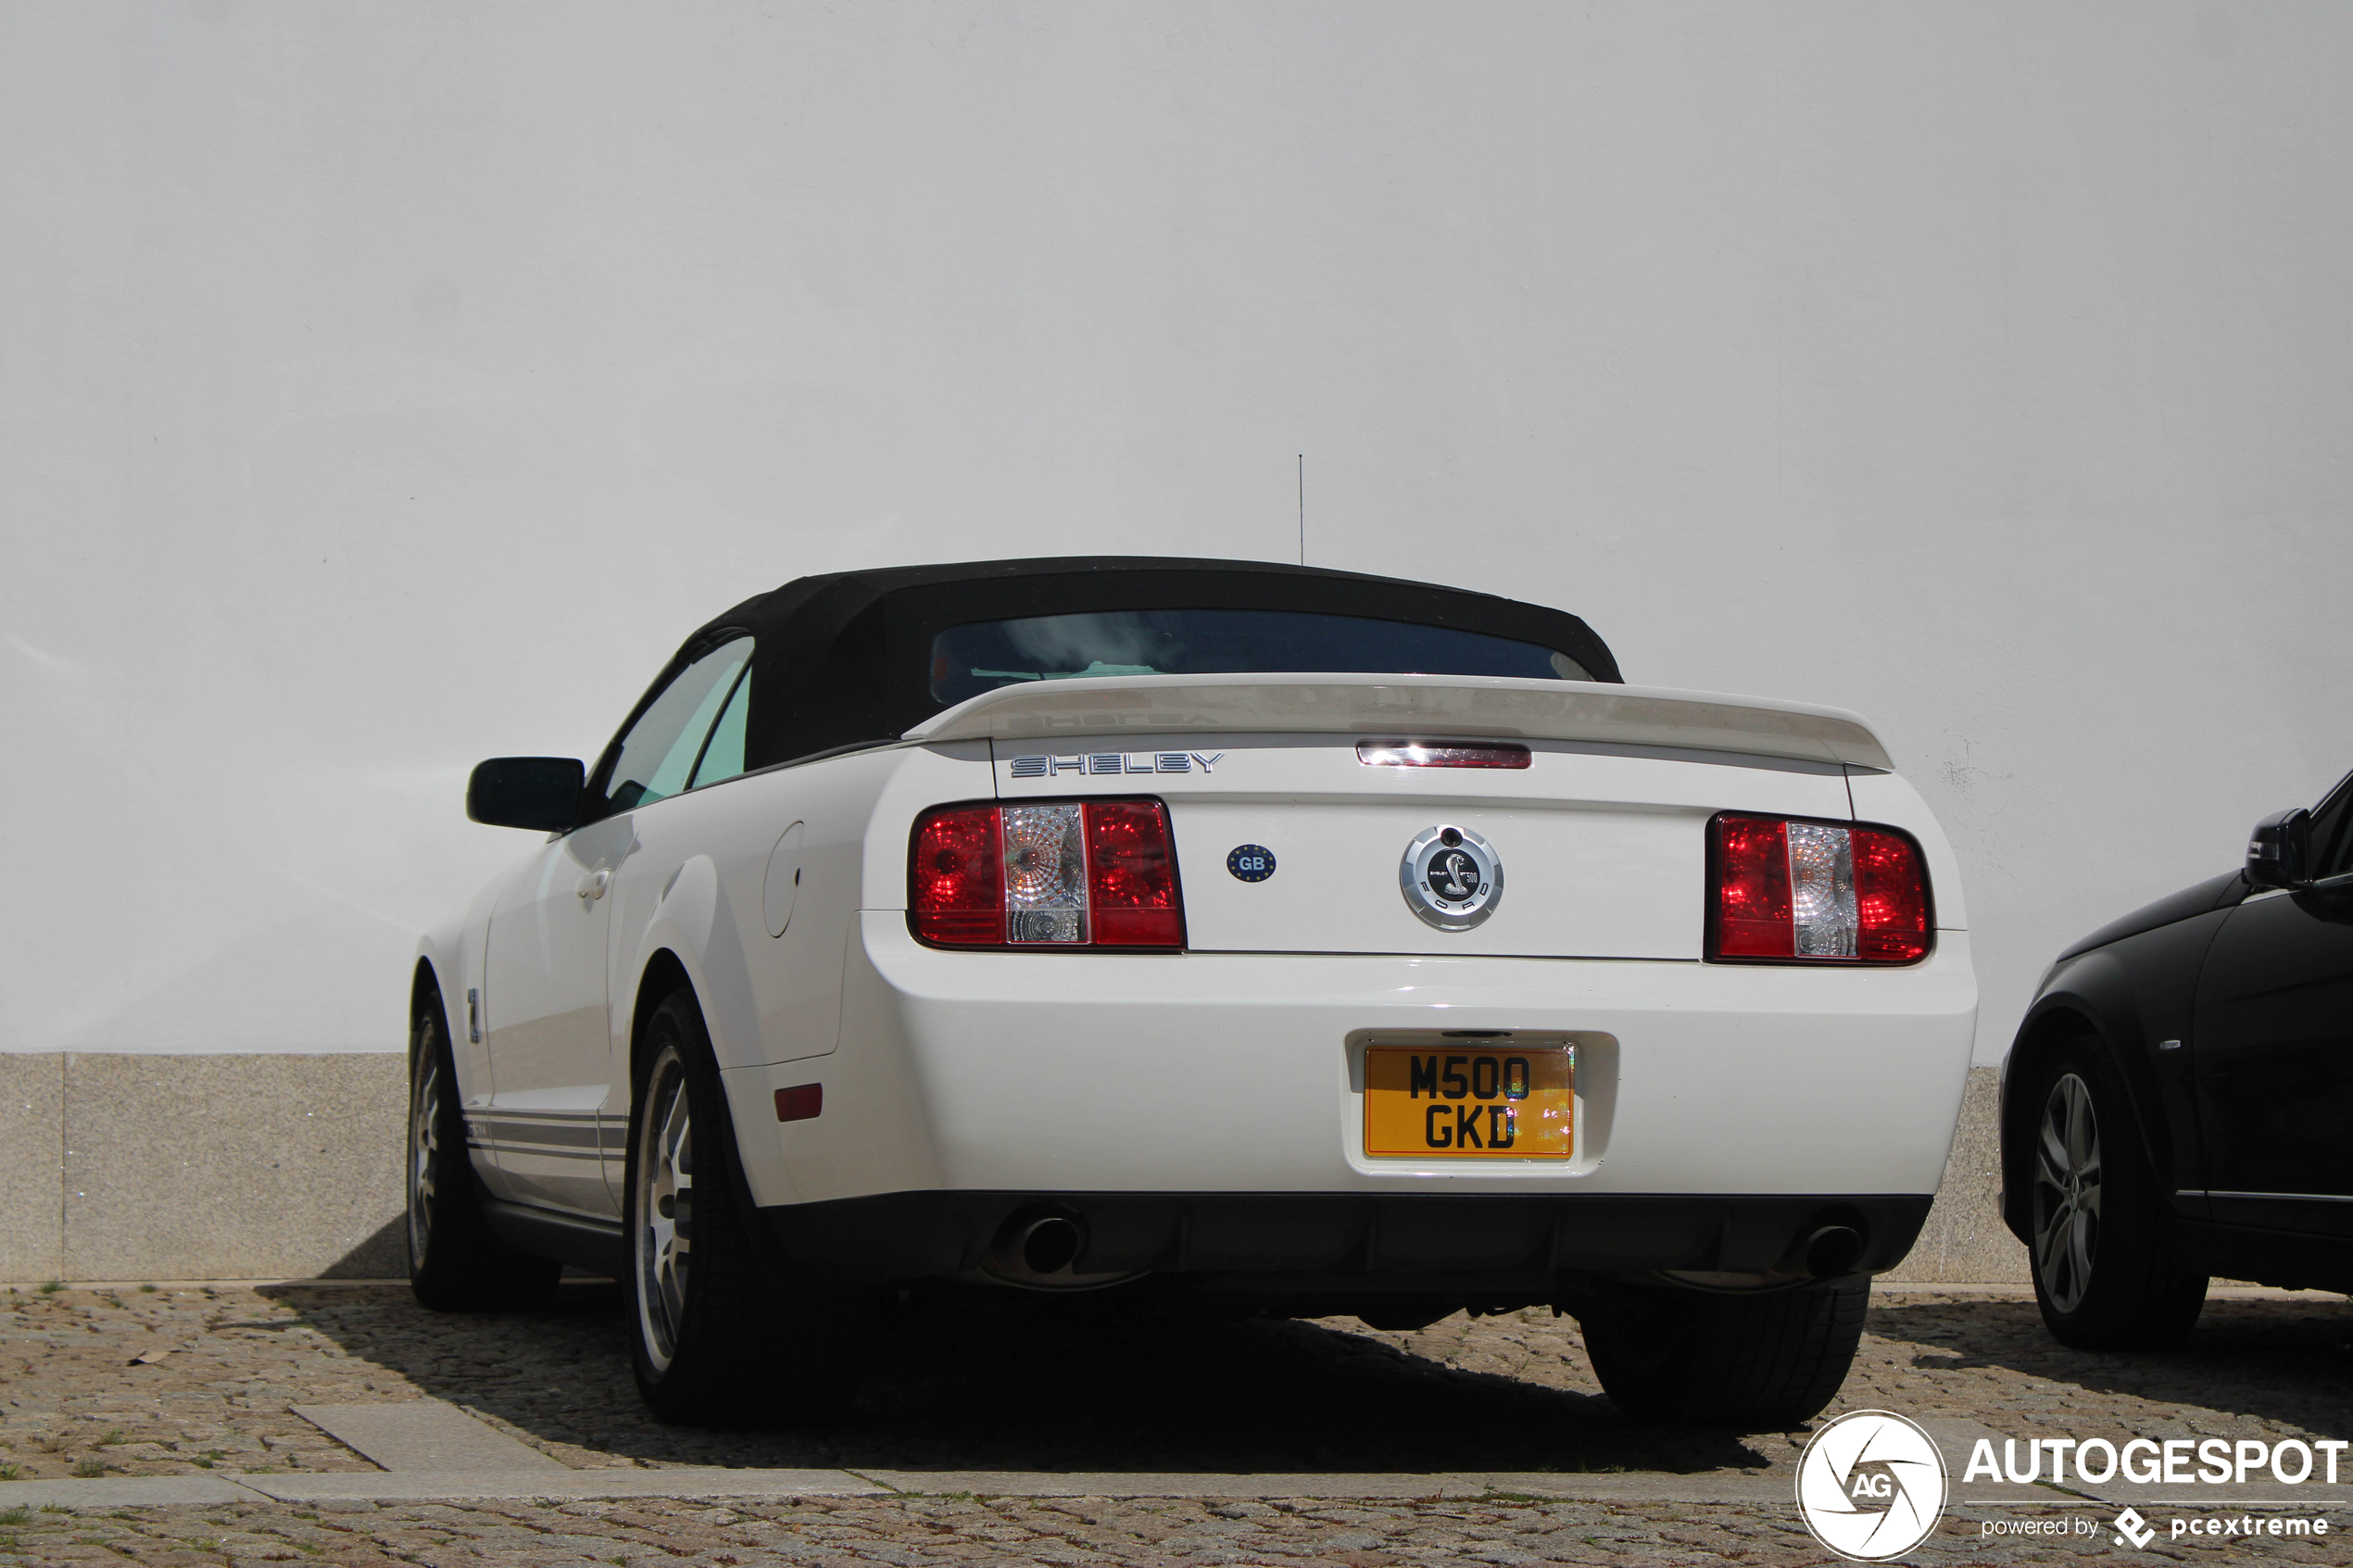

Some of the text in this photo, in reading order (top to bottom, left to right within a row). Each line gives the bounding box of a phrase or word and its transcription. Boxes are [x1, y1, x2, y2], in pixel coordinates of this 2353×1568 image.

[1011, 752, 1225, 778] SHELBY
[1239, 857, 1265, 871] GB
[1420, 882, 1489, 910] FORD
[1410, 1055, 1530, 1100] M500
[1426, 1105, 1515, 1148] GKD
